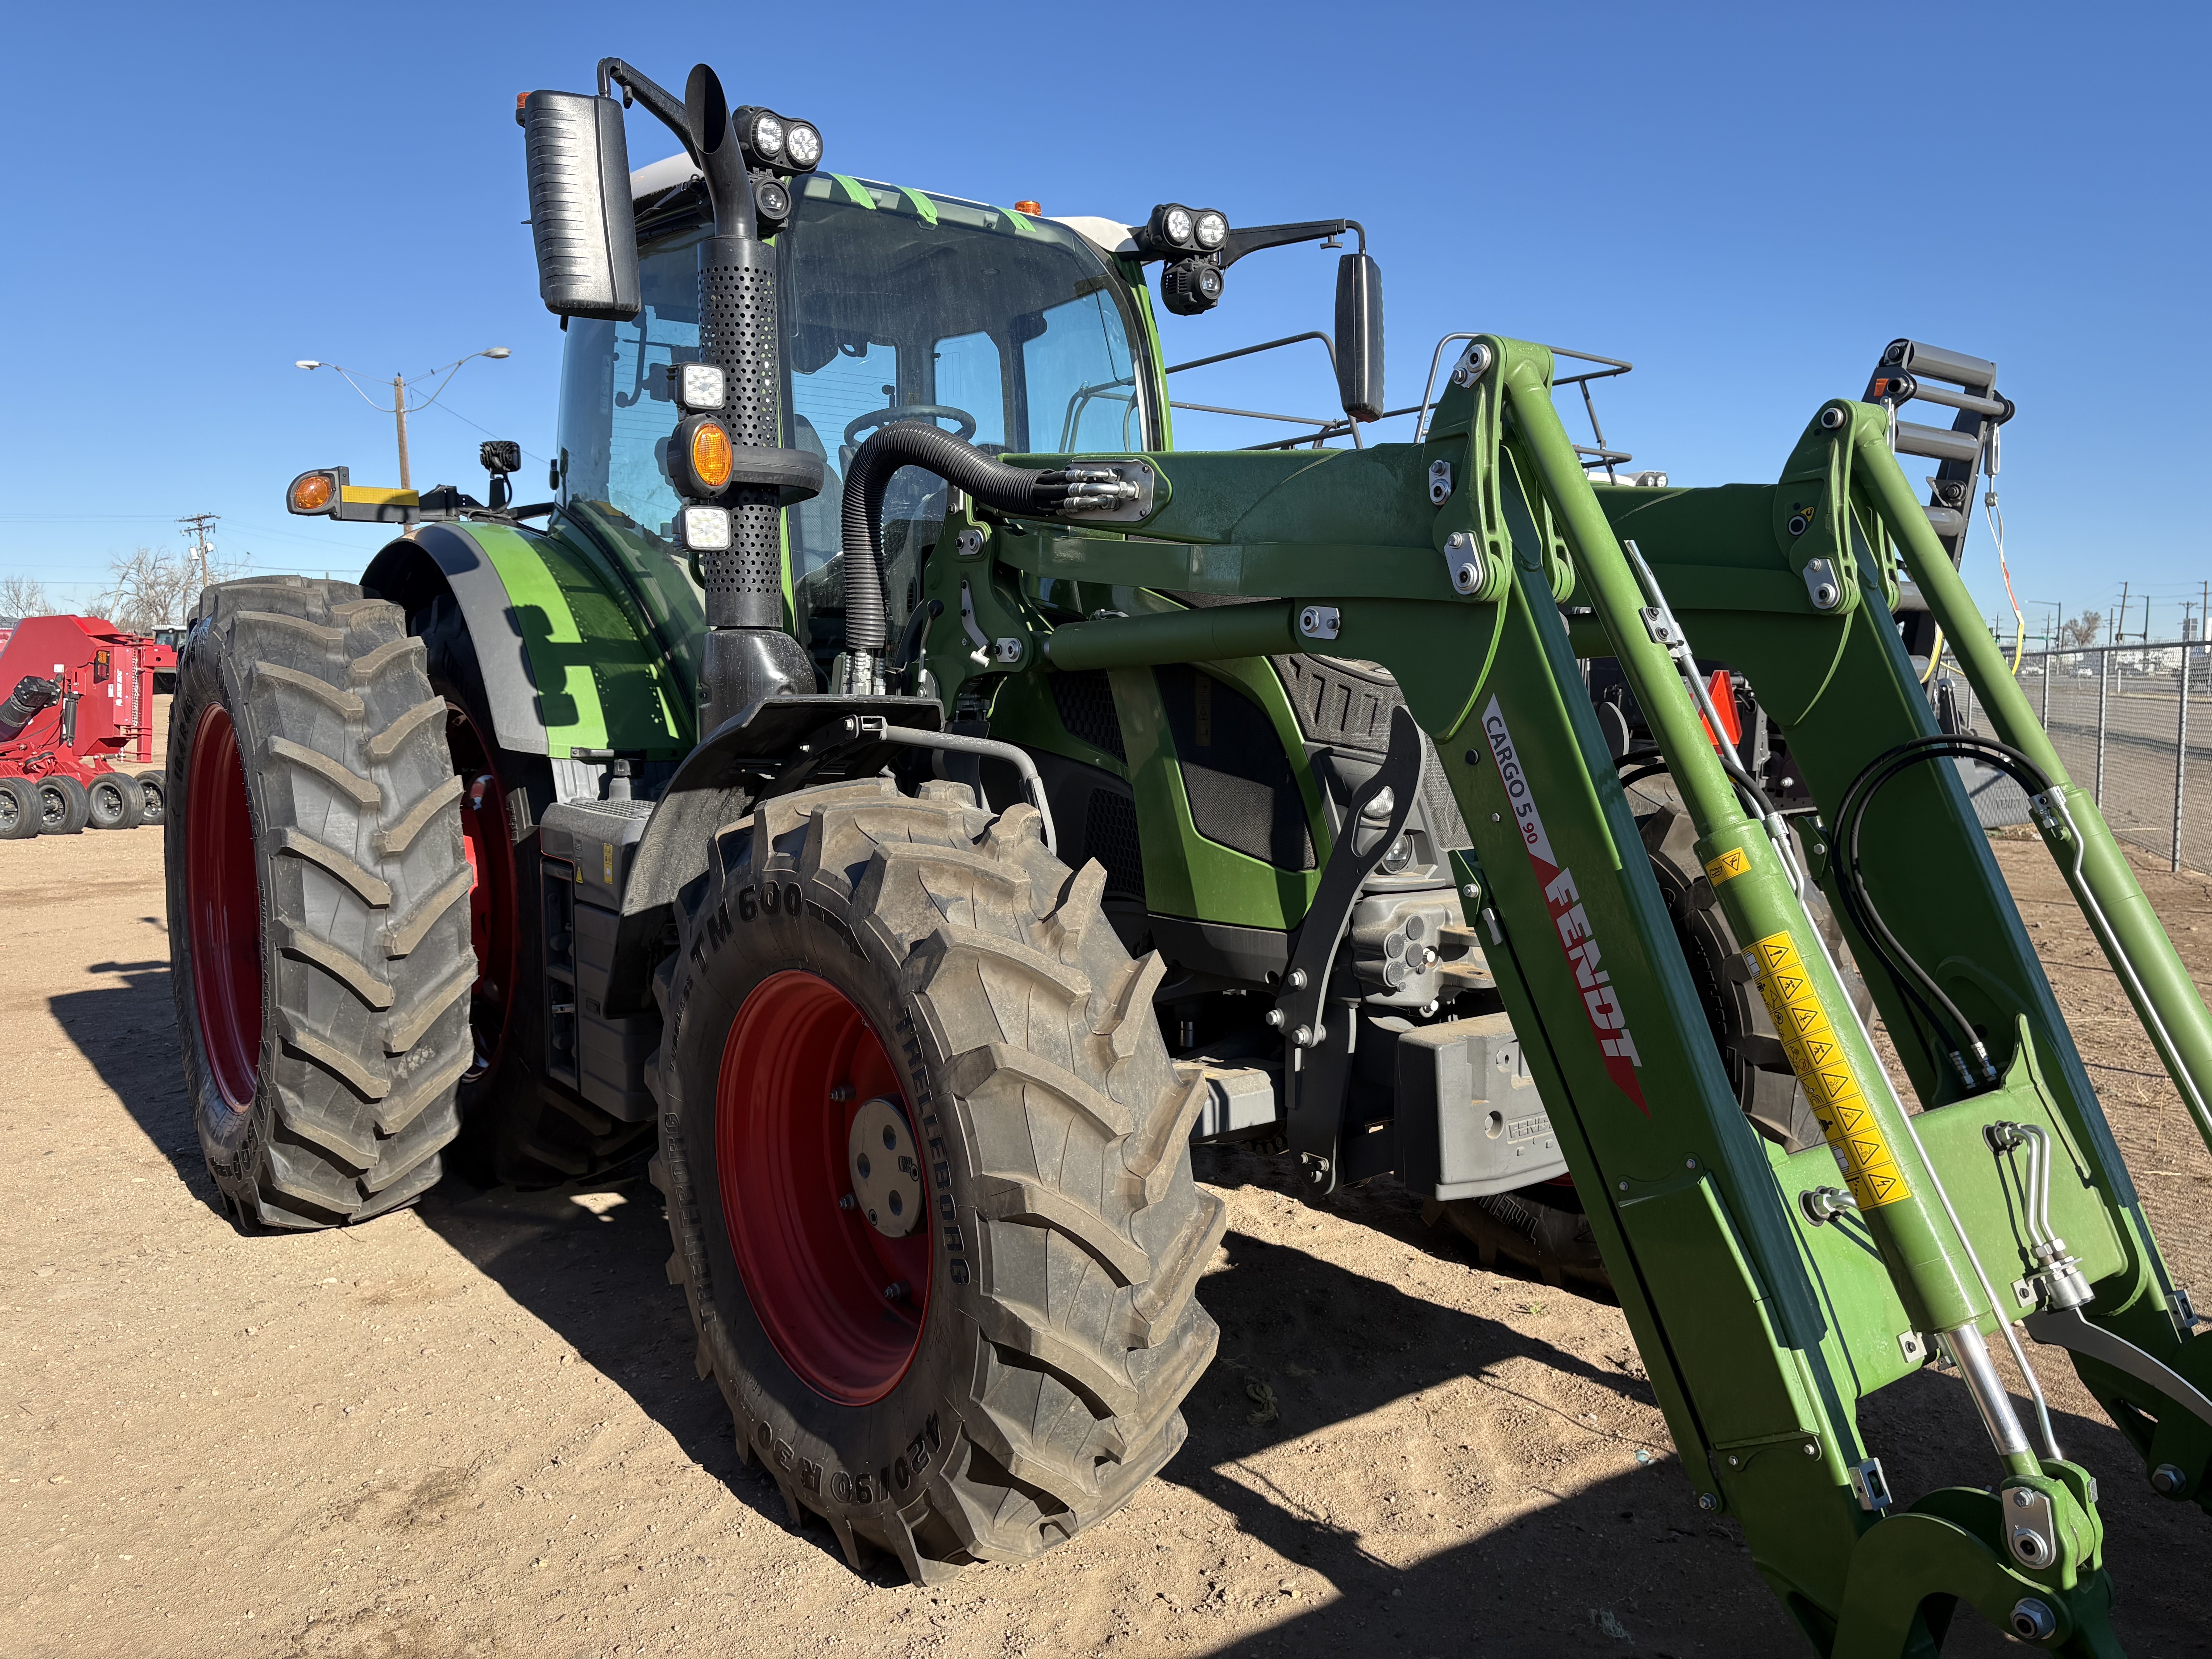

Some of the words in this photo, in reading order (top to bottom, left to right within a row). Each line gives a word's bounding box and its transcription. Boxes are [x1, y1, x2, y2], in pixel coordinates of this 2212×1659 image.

[1486, 716, 1525, 798] CARGO
[1516, 802, 1533, 817] 5
[1522, 822, 1538, 844] 90
[690, 897, 734, 977] TM
[738, 880, 803, 922] 600
[1544, 867, 1643, 1067] FENDT
[669, 974, 694, 1072] TUBELESS
[895, 1005, 971, 1286] TRELLEBORG
[1508, 1115, 1551, 1139] FEND
[664, 1112, 717, 1332] TRELLEBORG
[757, 1420, 795, 1474] 30
[800, 1457, 824, 1496] R
